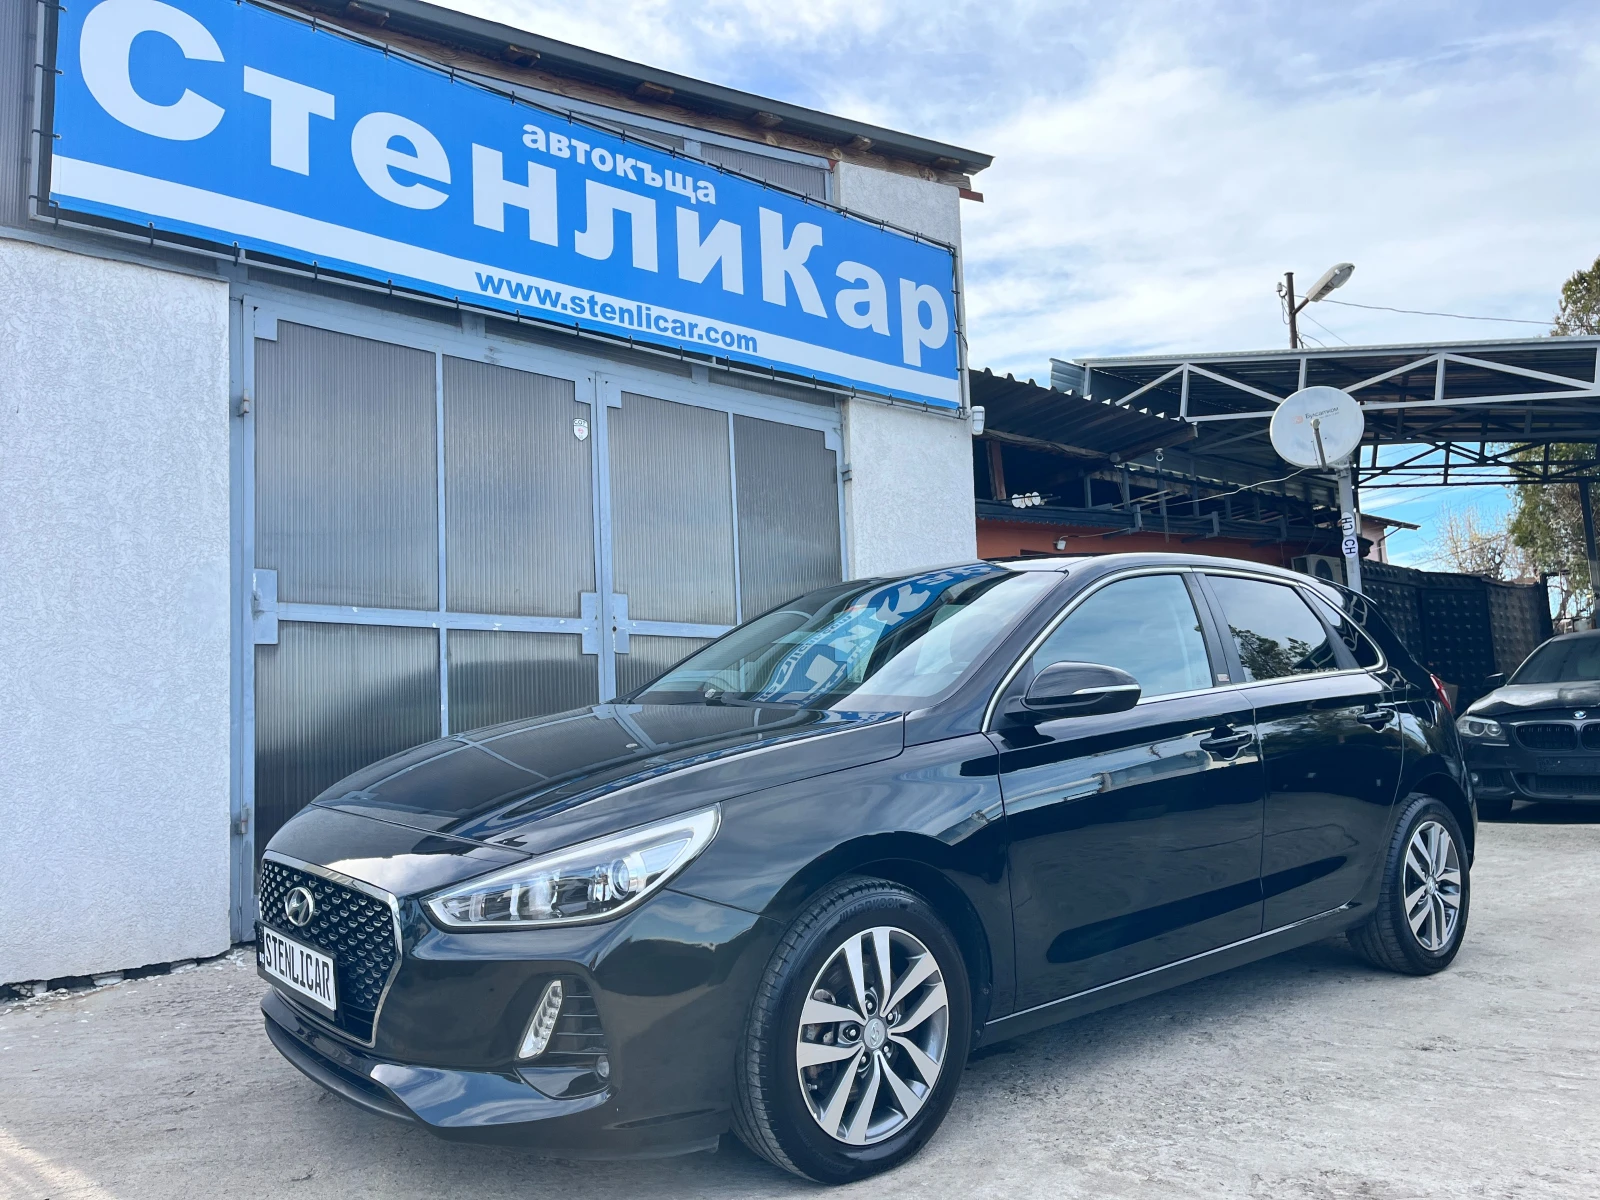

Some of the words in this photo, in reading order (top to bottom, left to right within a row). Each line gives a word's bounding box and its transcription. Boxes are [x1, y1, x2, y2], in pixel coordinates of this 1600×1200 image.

[79, 0, 949, 368] СтенлиКар
[522, 123, 717, 205] автокъща
[474, 271, 758, 353] www.stenlicar.com
[1344, 539, 1356, 555] CH
[265, 932, 331, 1001] STENLICAR
